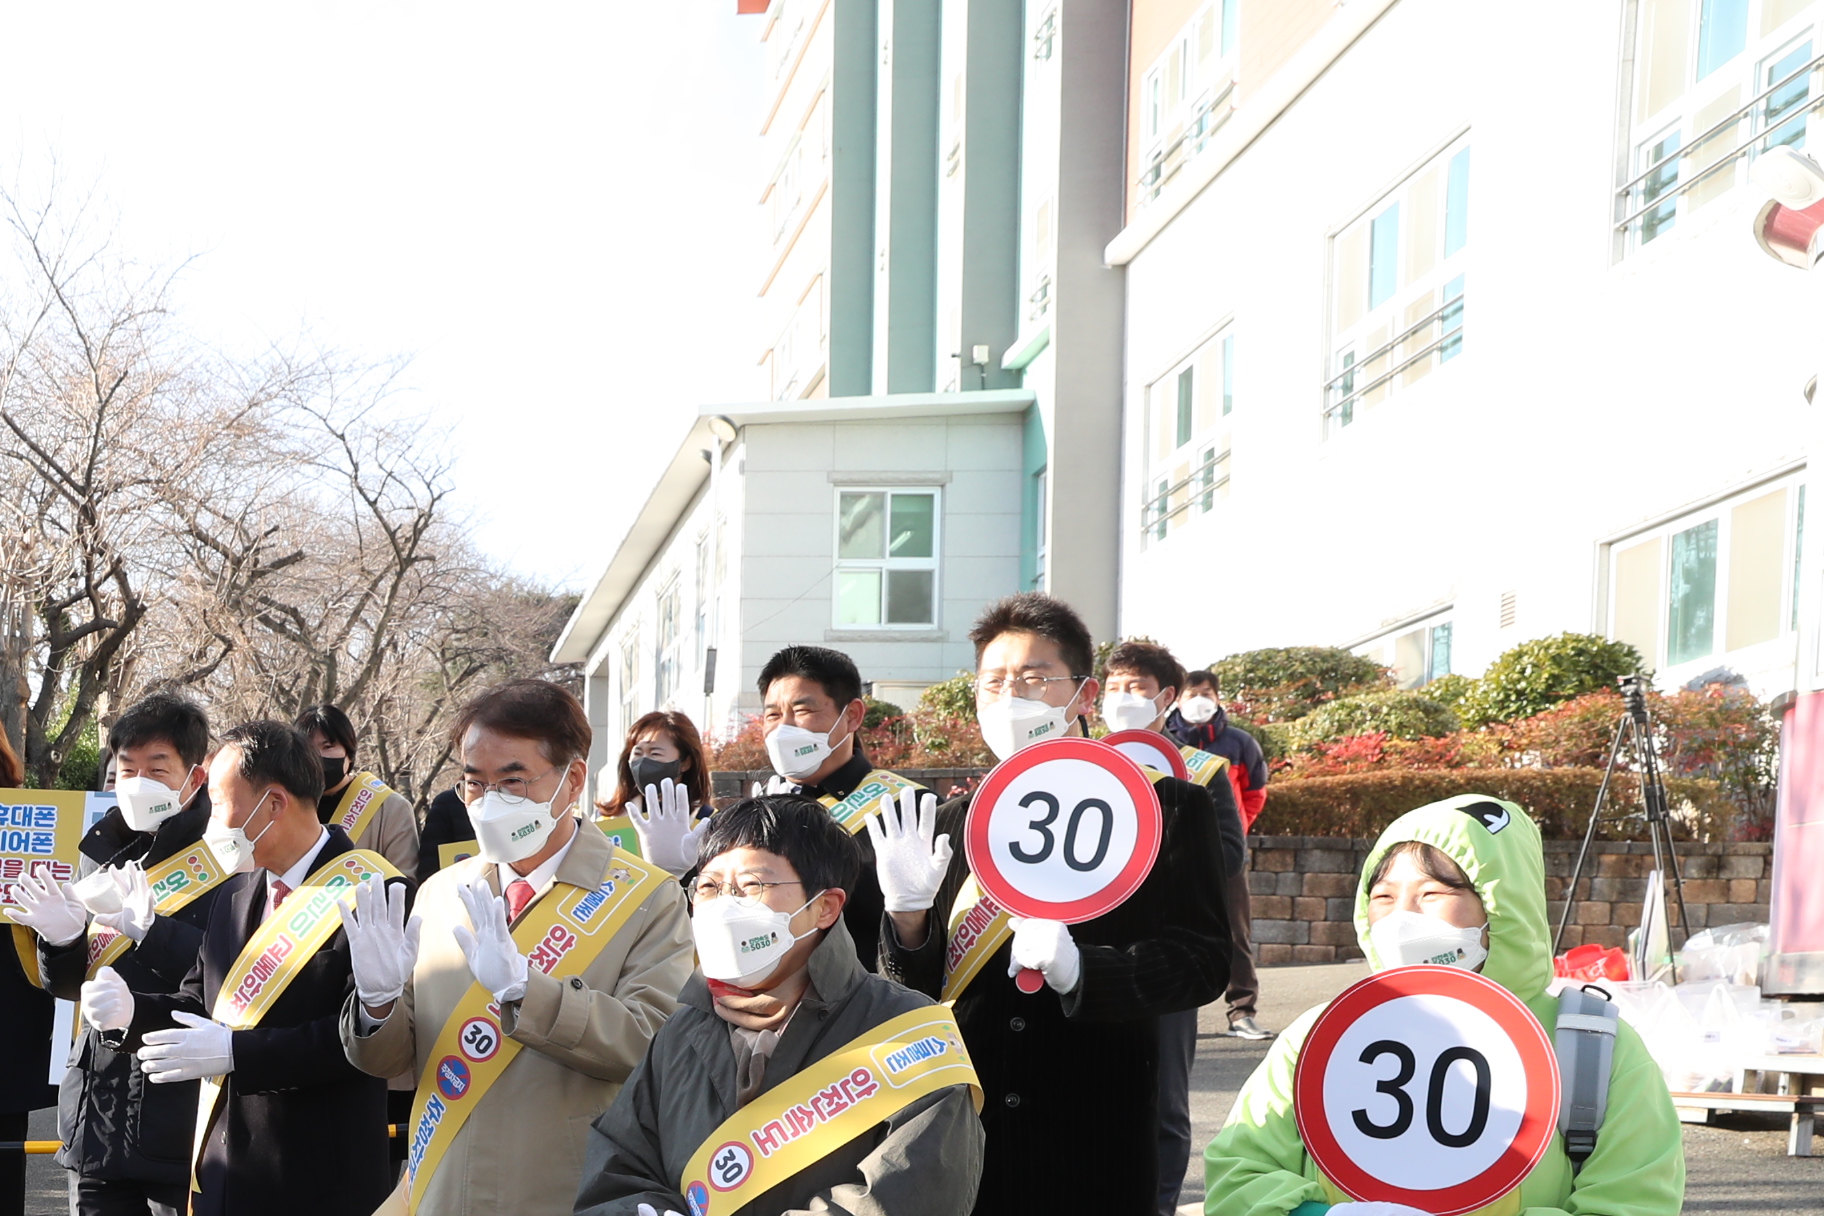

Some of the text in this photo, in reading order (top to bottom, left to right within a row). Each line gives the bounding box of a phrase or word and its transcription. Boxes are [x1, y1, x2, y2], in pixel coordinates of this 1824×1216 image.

[1008, 791, 1114, 872] 30
[290, 875, 352, 938] 어린이
[572, 881, 613, 921] 스쿨존
[750, 940, 770, 951] 5030
[464, 1025, 494, 1054] 30
[887, 1038, 945, 1072] 스쿨존
[752, 1069, 878, 1155] 안전속도
[1351, 1040, 1491, 1148] 30
[716, 1149, 743, 1183] 30
